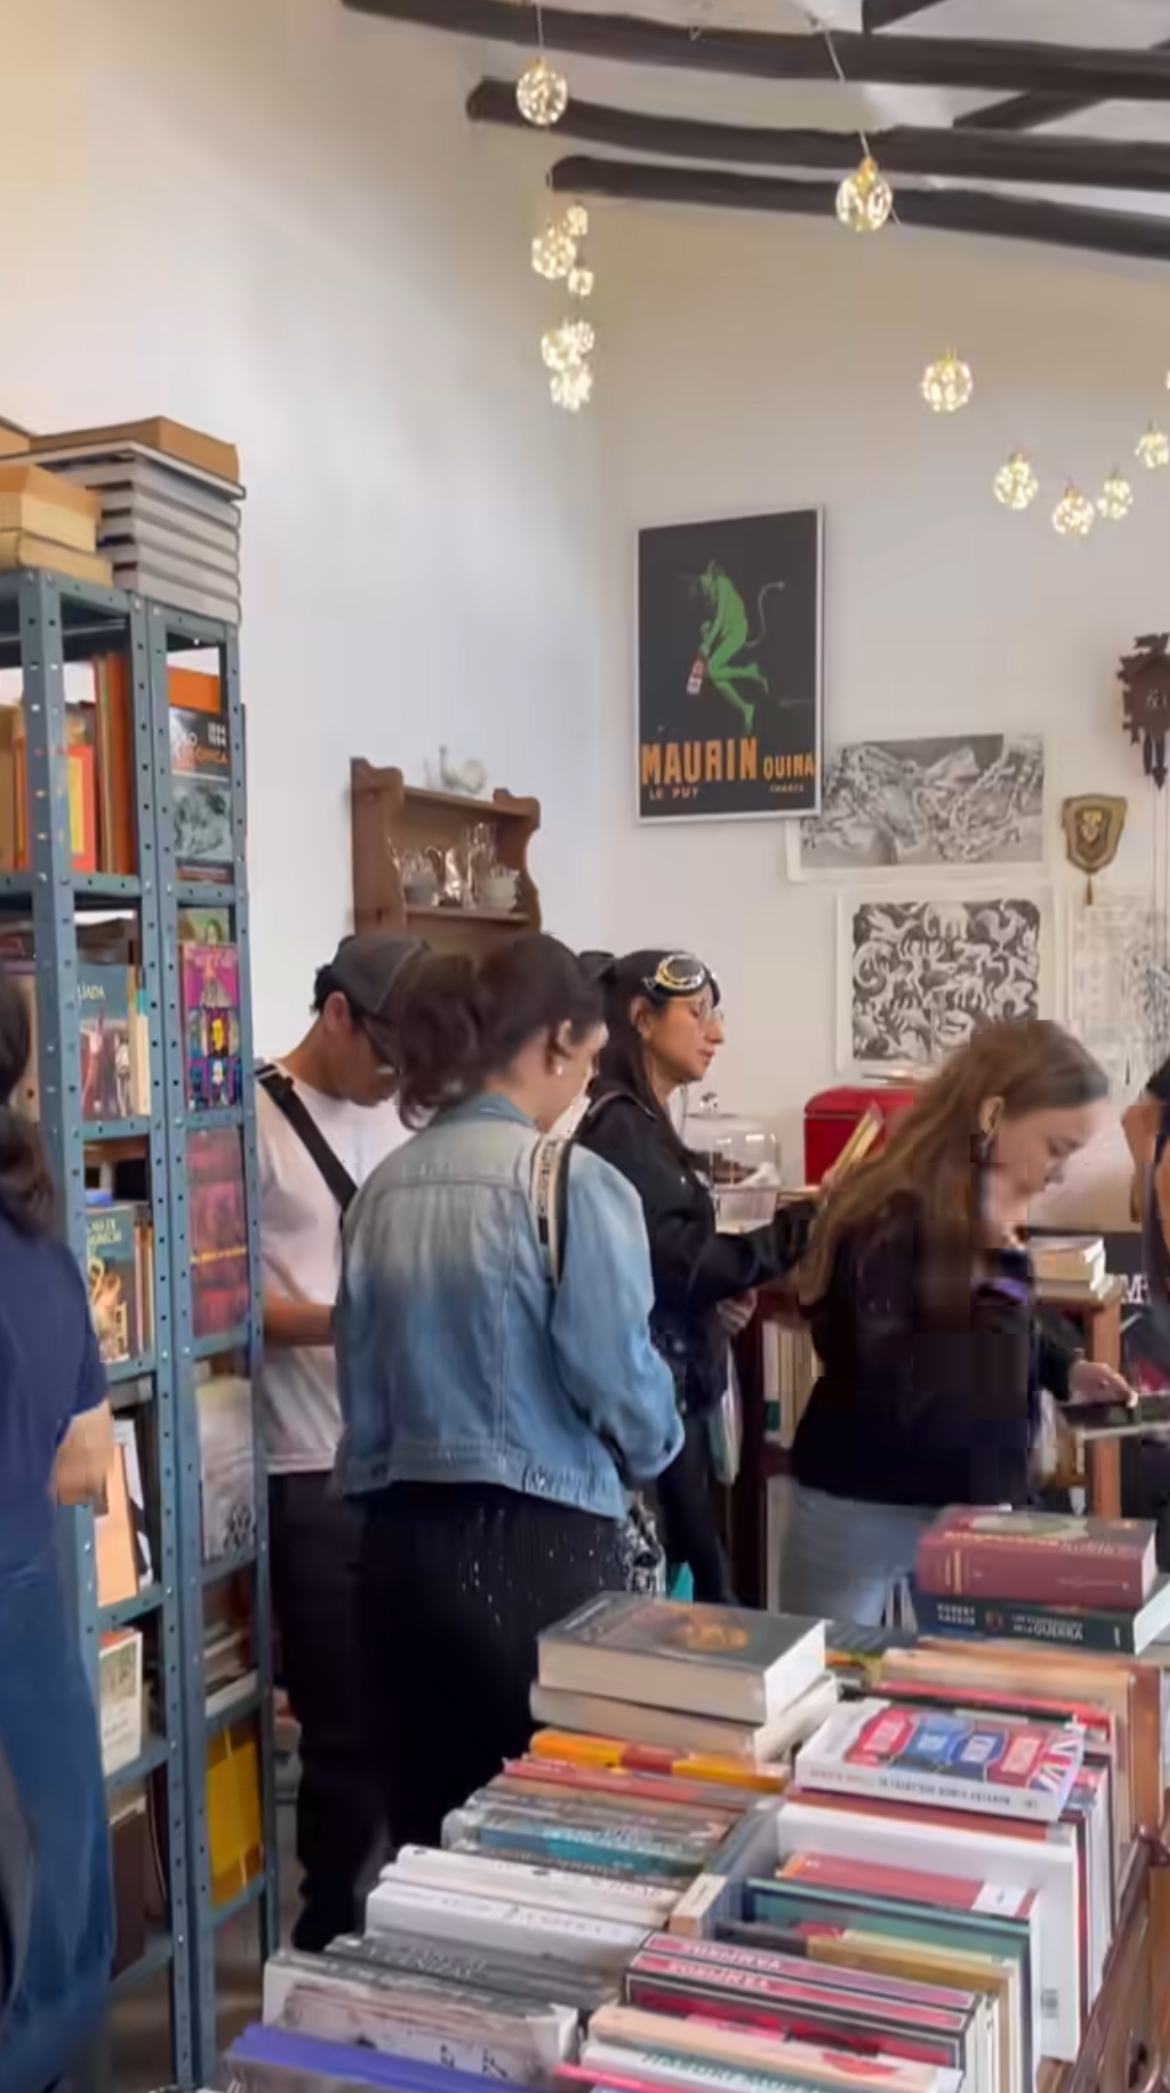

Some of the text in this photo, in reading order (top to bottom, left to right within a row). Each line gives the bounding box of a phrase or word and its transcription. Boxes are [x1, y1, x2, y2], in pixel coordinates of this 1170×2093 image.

[641, 736, 757, 787] MAURIN
[650, 785, 699, 800] LE PUY
[1034, 1621, 1084, 1642] GUERRA
